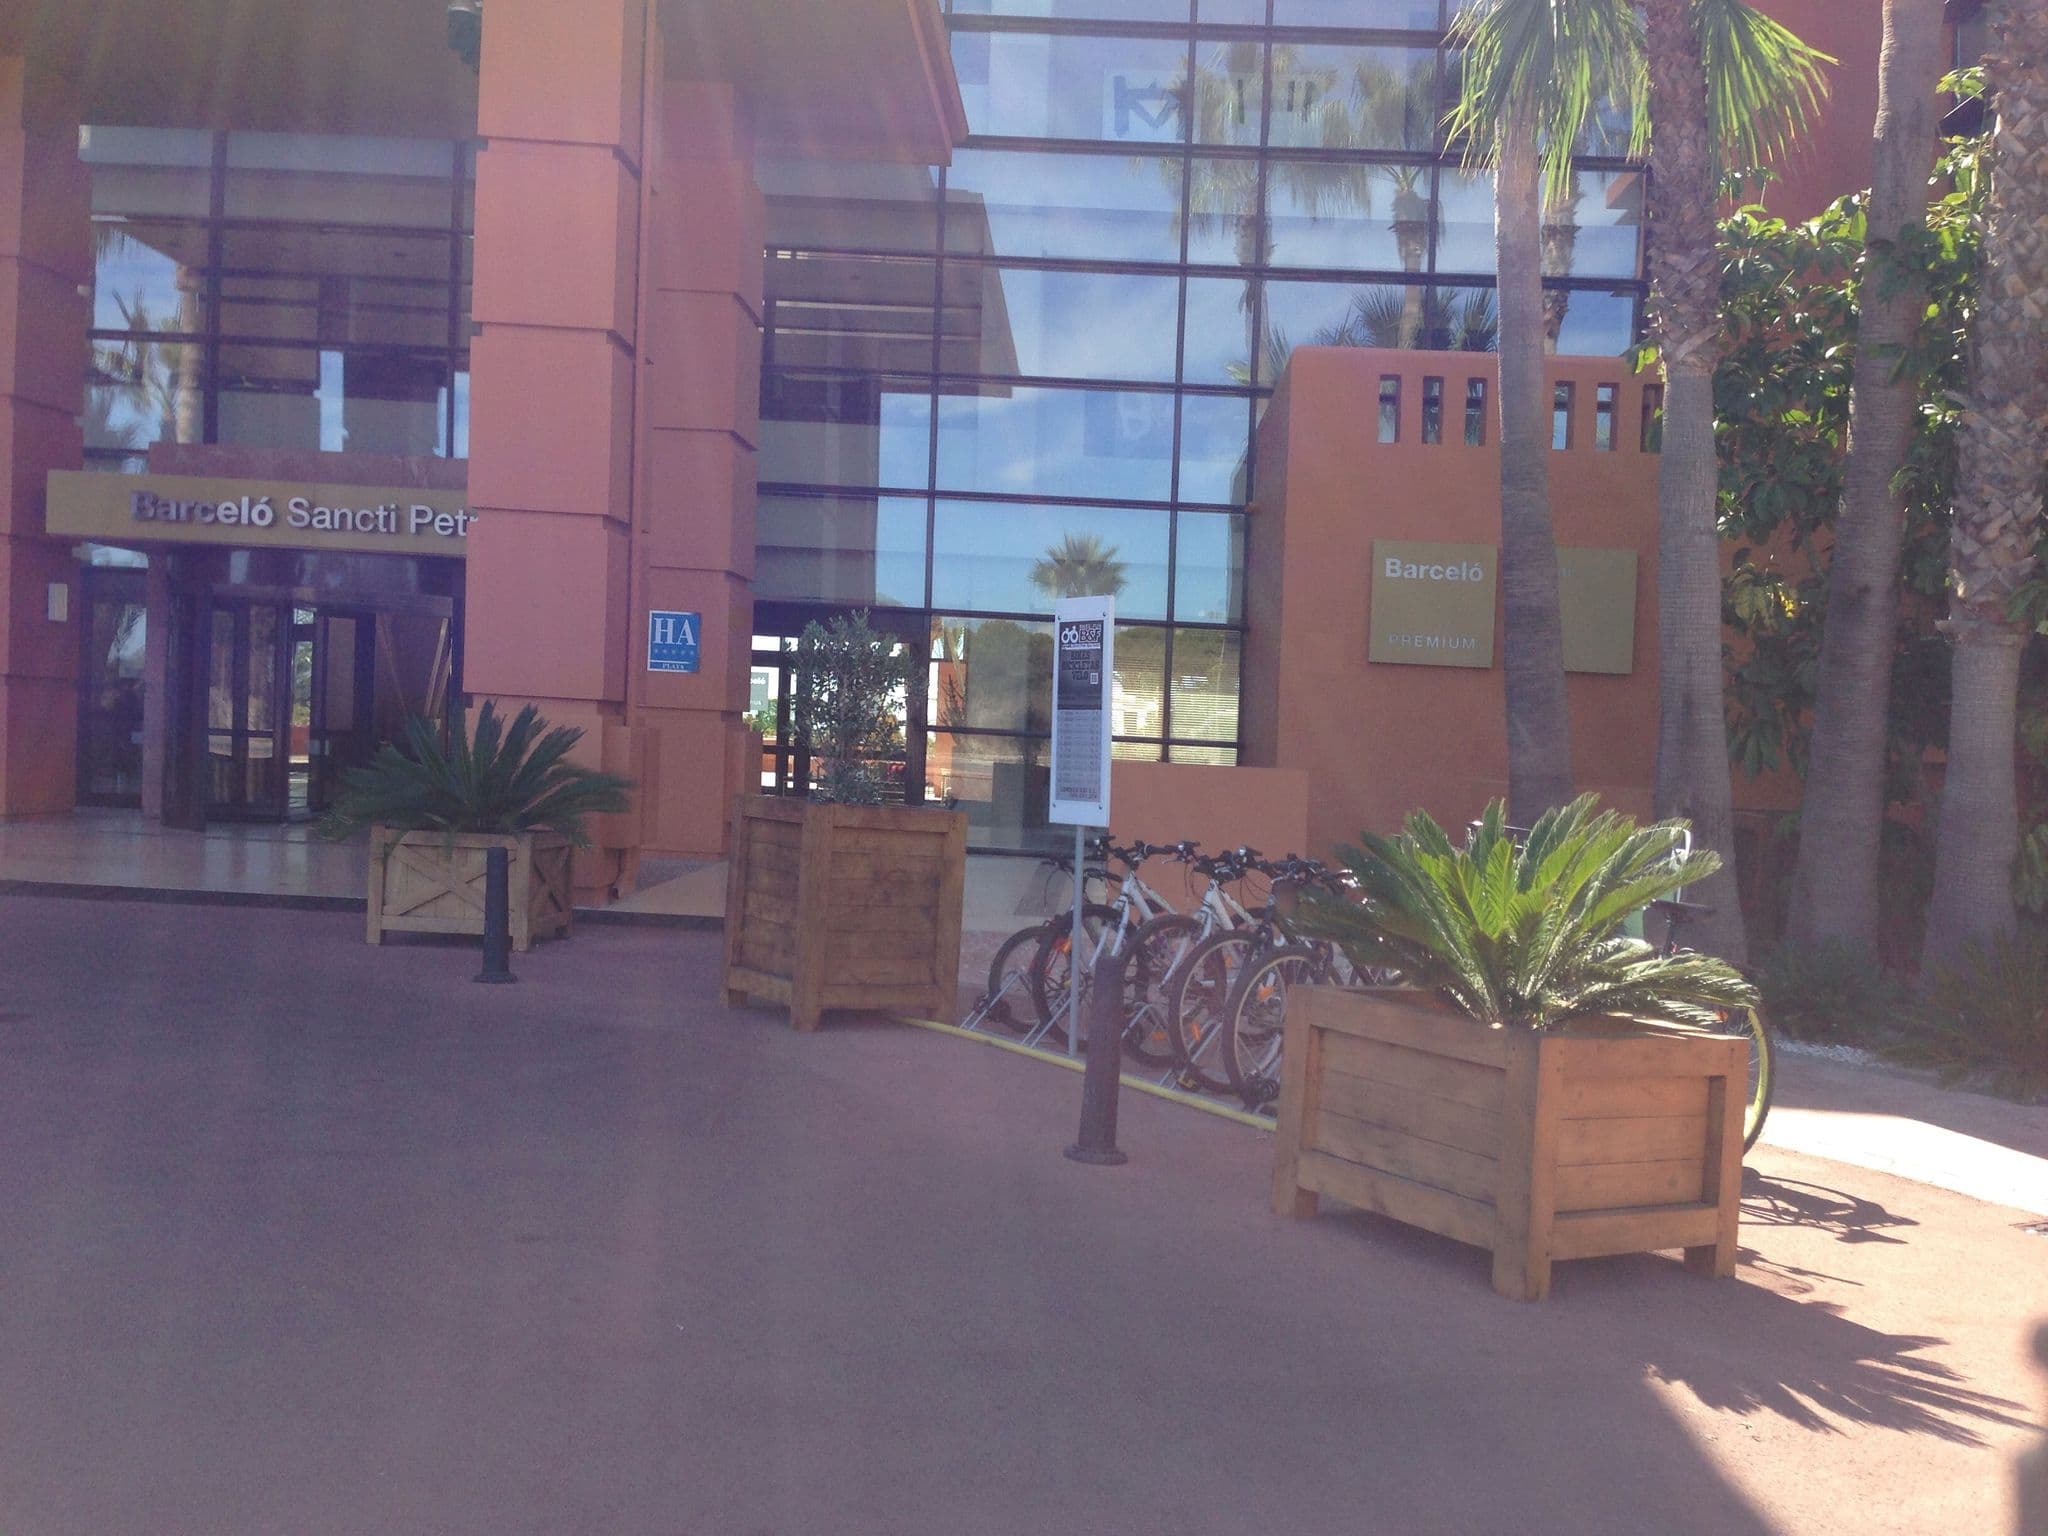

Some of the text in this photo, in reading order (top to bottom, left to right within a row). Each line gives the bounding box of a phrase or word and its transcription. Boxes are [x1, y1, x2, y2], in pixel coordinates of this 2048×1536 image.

[130, 490, 273, 526] Barceló
[287, 497, 396, 533] Sancti
[1384, 557, 1484, 582] Barceló
[653, 617, 697, 646] HA
[1387, 632, 1477, 649] PREMIUM
